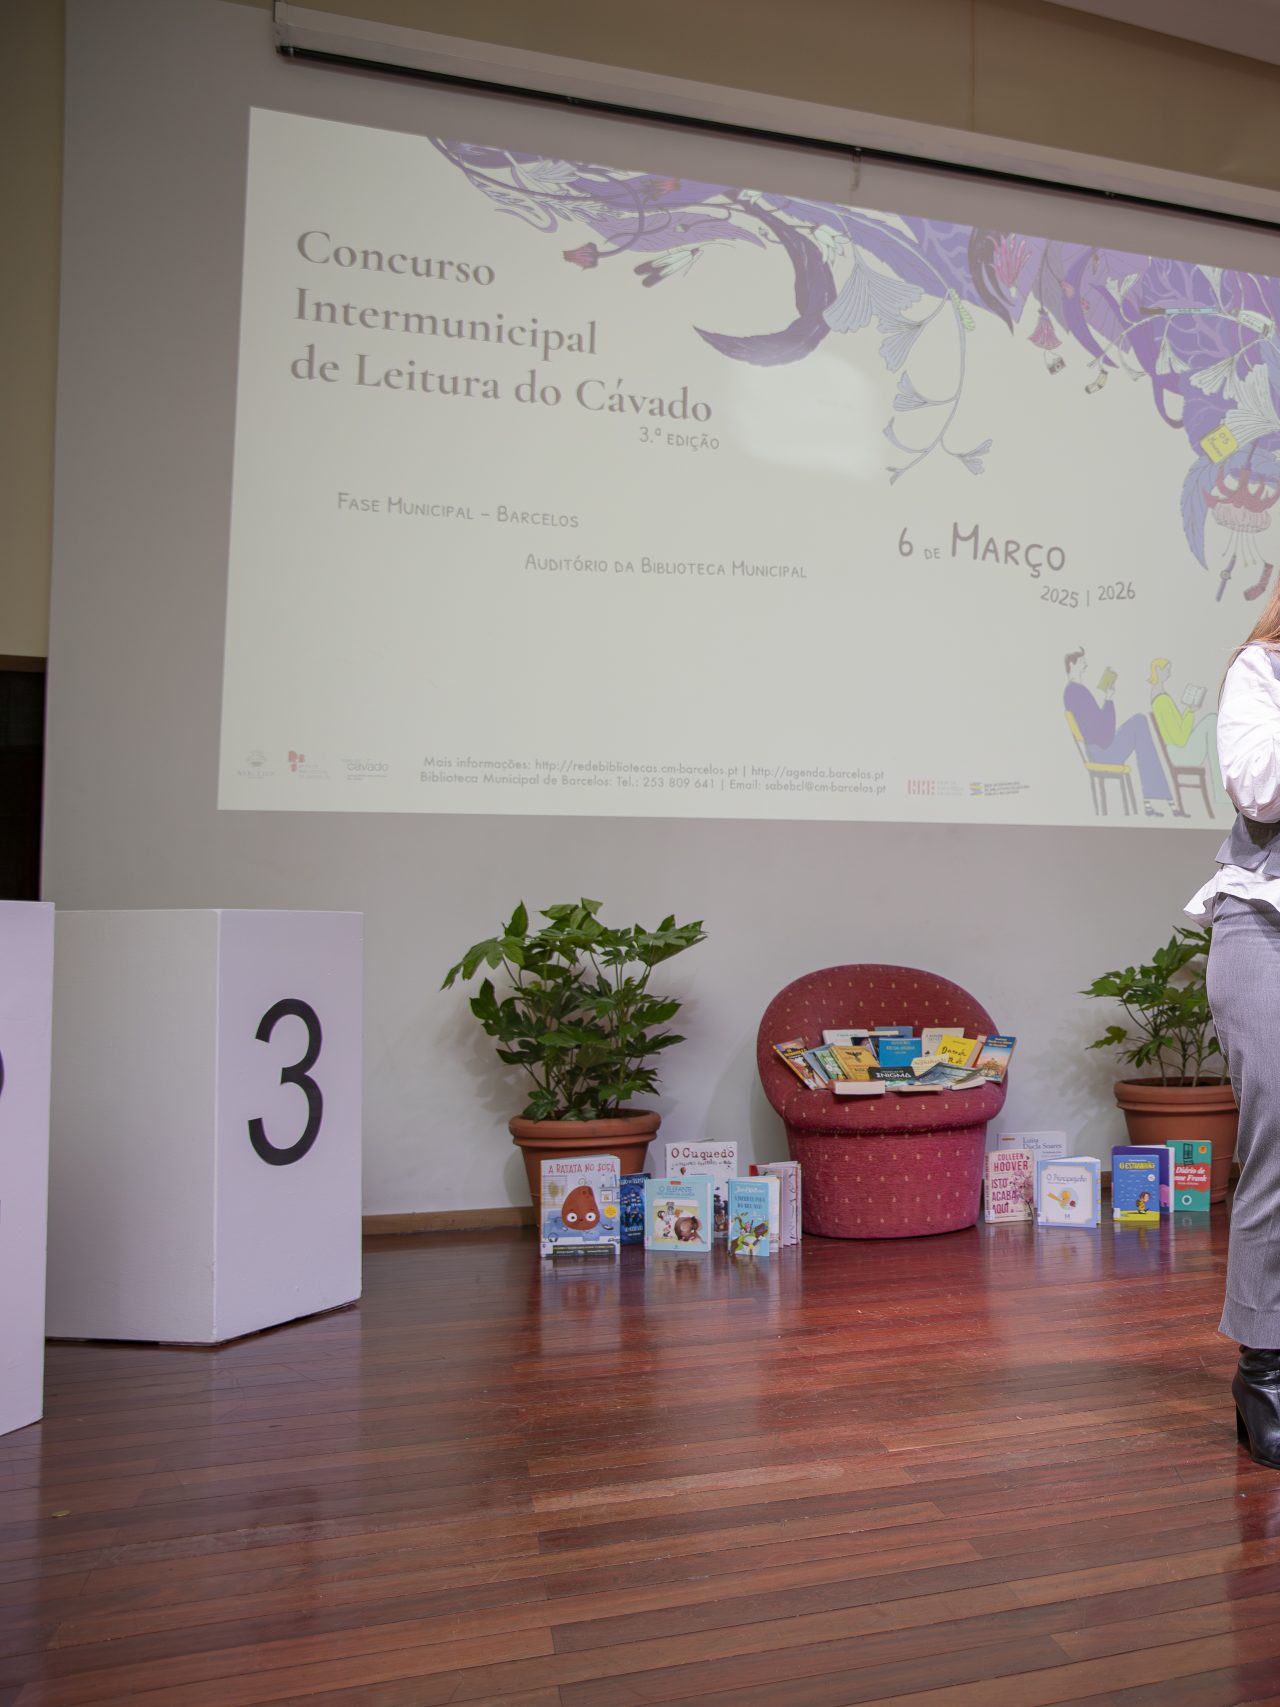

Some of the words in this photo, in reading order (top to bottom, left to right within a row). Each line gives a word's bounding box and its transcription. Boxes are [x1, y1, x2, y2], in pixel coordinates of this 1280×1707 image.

[296, 230, 496, 286] Concurso
[294, 287, 598, 361] Intermunicipal
[290, 344, 340, 382] de
[355, 353, 501, 399] Leitura
[514, 369, 561, 405] do
[576, 378, 713, 422] Cávado
[666, 430, 720, 451] EDIÇÃO
[337, 492, 380, 513] FASE
[388, 496, 474, 520] MUNICIPAL
[497, 505, 579, 527] BARCELOS
[898, 527, 914, 557] 6
[924, 548, 941, 560] DE
[951, 521, 1066, 578] MARÇO
[525, 553, 608, 574] AUDITÓRIO
[614, 559, 635, 574] DA
[641, 556, 726, 576] BIBLIOTECA
[732, 559, 807, 578] MUNICIPAL
[1040, 585, 1079, 608] 2025
[1098, 581, 1136, 601] 2026
[420, 771, 478, 784] Biblioteca
[483, 773, 539, 787] Municipal
[543, 774, 557, 786] de
[642, 777, 665, 788] 253
[668, 777, 691, 789] 809
[694, 778, 716, 789] 641
[729, 779, 761, 791] Email:
[424, 756, 453, 769] Mais
[456, 756, 531, 772] informações:
[752, 765, 884, 781] http://agenda.barcelos.pt
[248, 998, 324, 1166] 3
[671, 1147, 680, 1159] O
[682, 1147, 735, 1161] Cuquedo
[993, 1161, 1029, 1172] HOOVER
[997, 1153, 1024, 1161] COLLEEN
